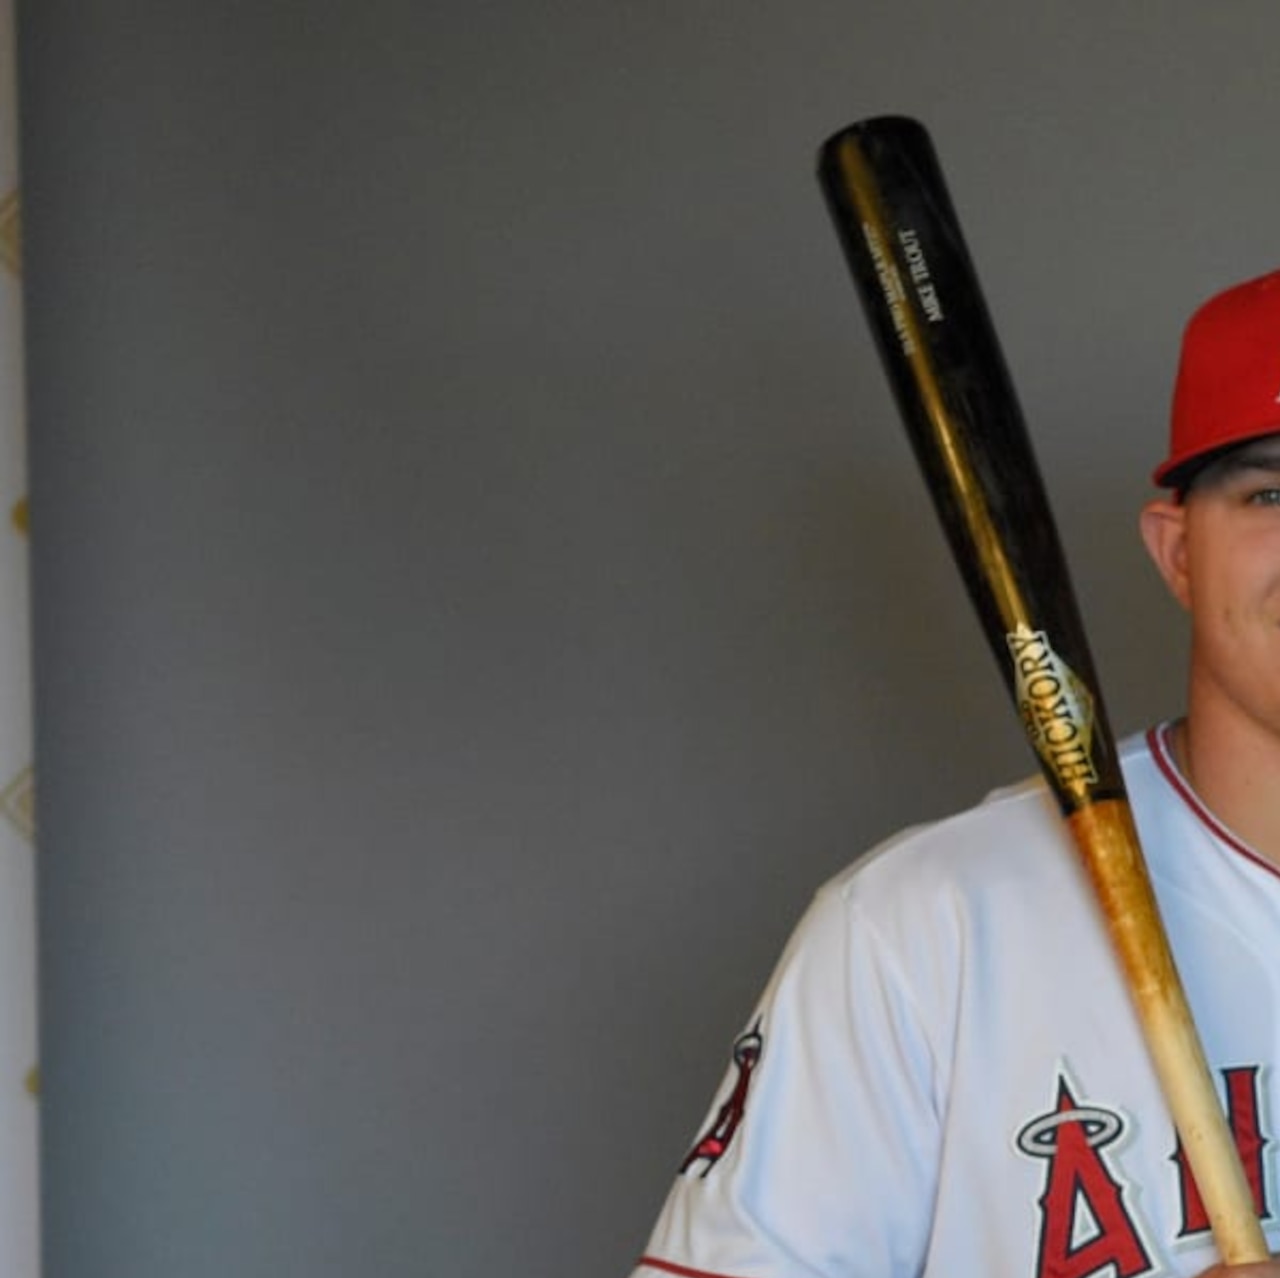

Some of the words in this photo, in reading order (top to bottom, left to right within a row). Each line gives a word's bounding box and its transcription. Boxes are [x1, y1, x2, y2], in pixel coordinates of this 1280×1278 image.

[898, 228, 930, 284] TROUT
[917, 282, 945, 322] MIKE
[1008, 631, 1095, 785] HICKORY
